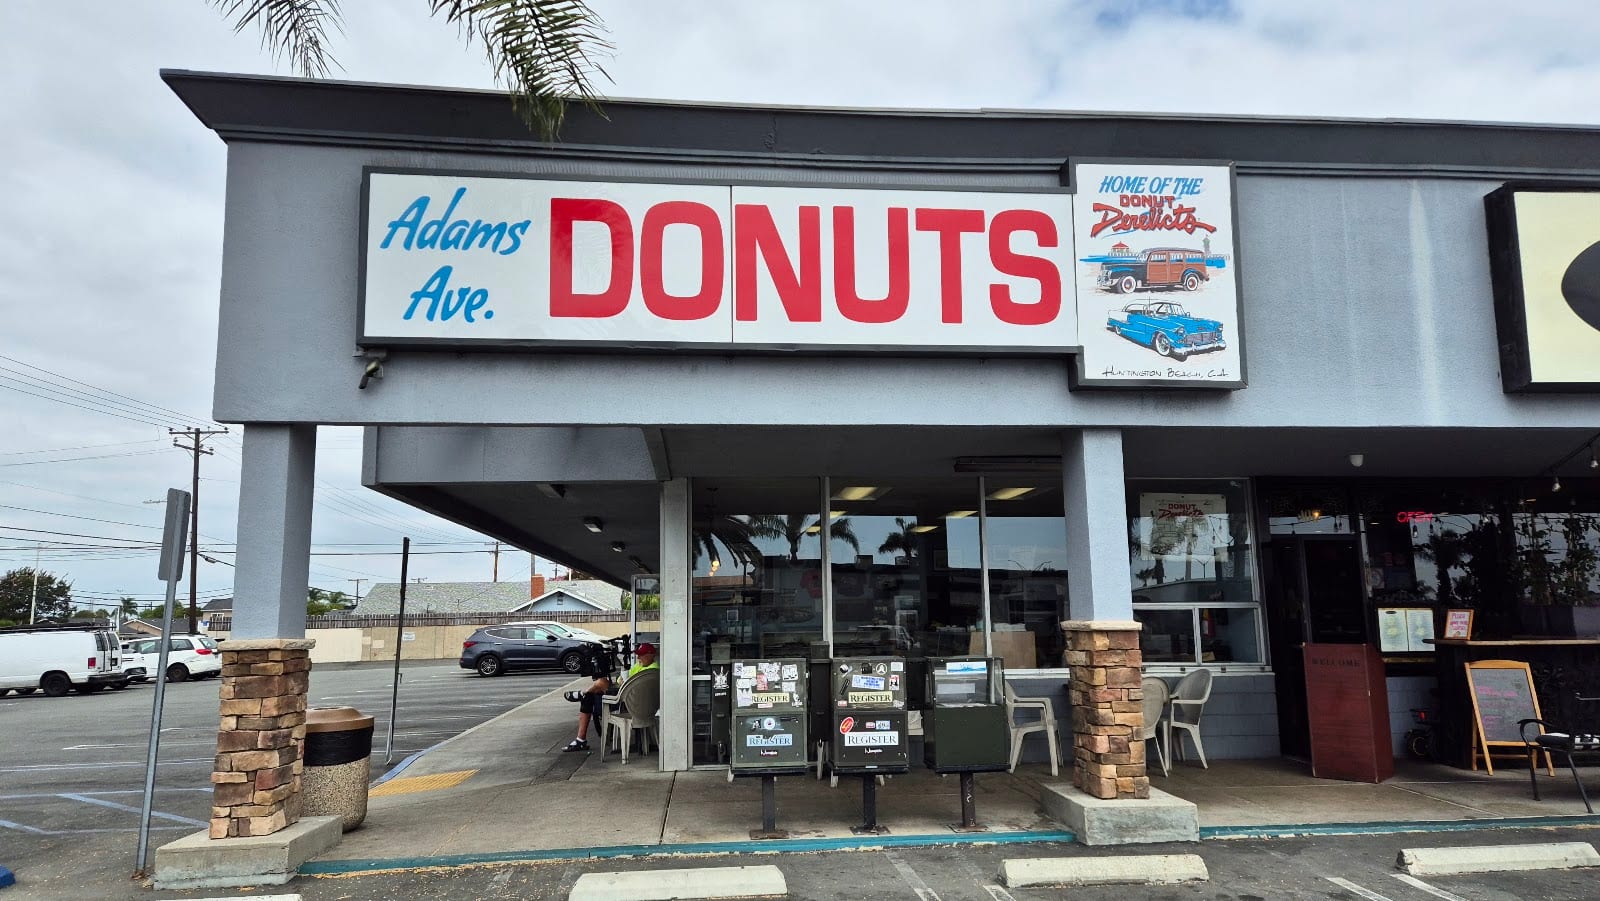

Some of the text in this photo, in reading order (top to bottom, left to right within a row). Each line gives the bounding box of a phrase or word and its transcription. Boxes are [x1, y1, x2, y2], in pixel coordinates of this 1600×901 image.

[1099, 175, 1204, 195] HOME OF THE
[1119, 194, 1176, 208] DONUT
[380, 187, 531, 255] Adams
[1090, 202, 1217, 238] Derelicts
[550, 197, 1062, 325] DONUTS
[403, 265, 494, 323] Ave.
[1168, 503, 1198, 511] DONUT
[1397, 511, 1433, 523] OPEN
[752, 694, 788, 703] REGISTER
[850, 694, 891, 703] REGISTER
[848, 735, 897, 745] REGISTER
